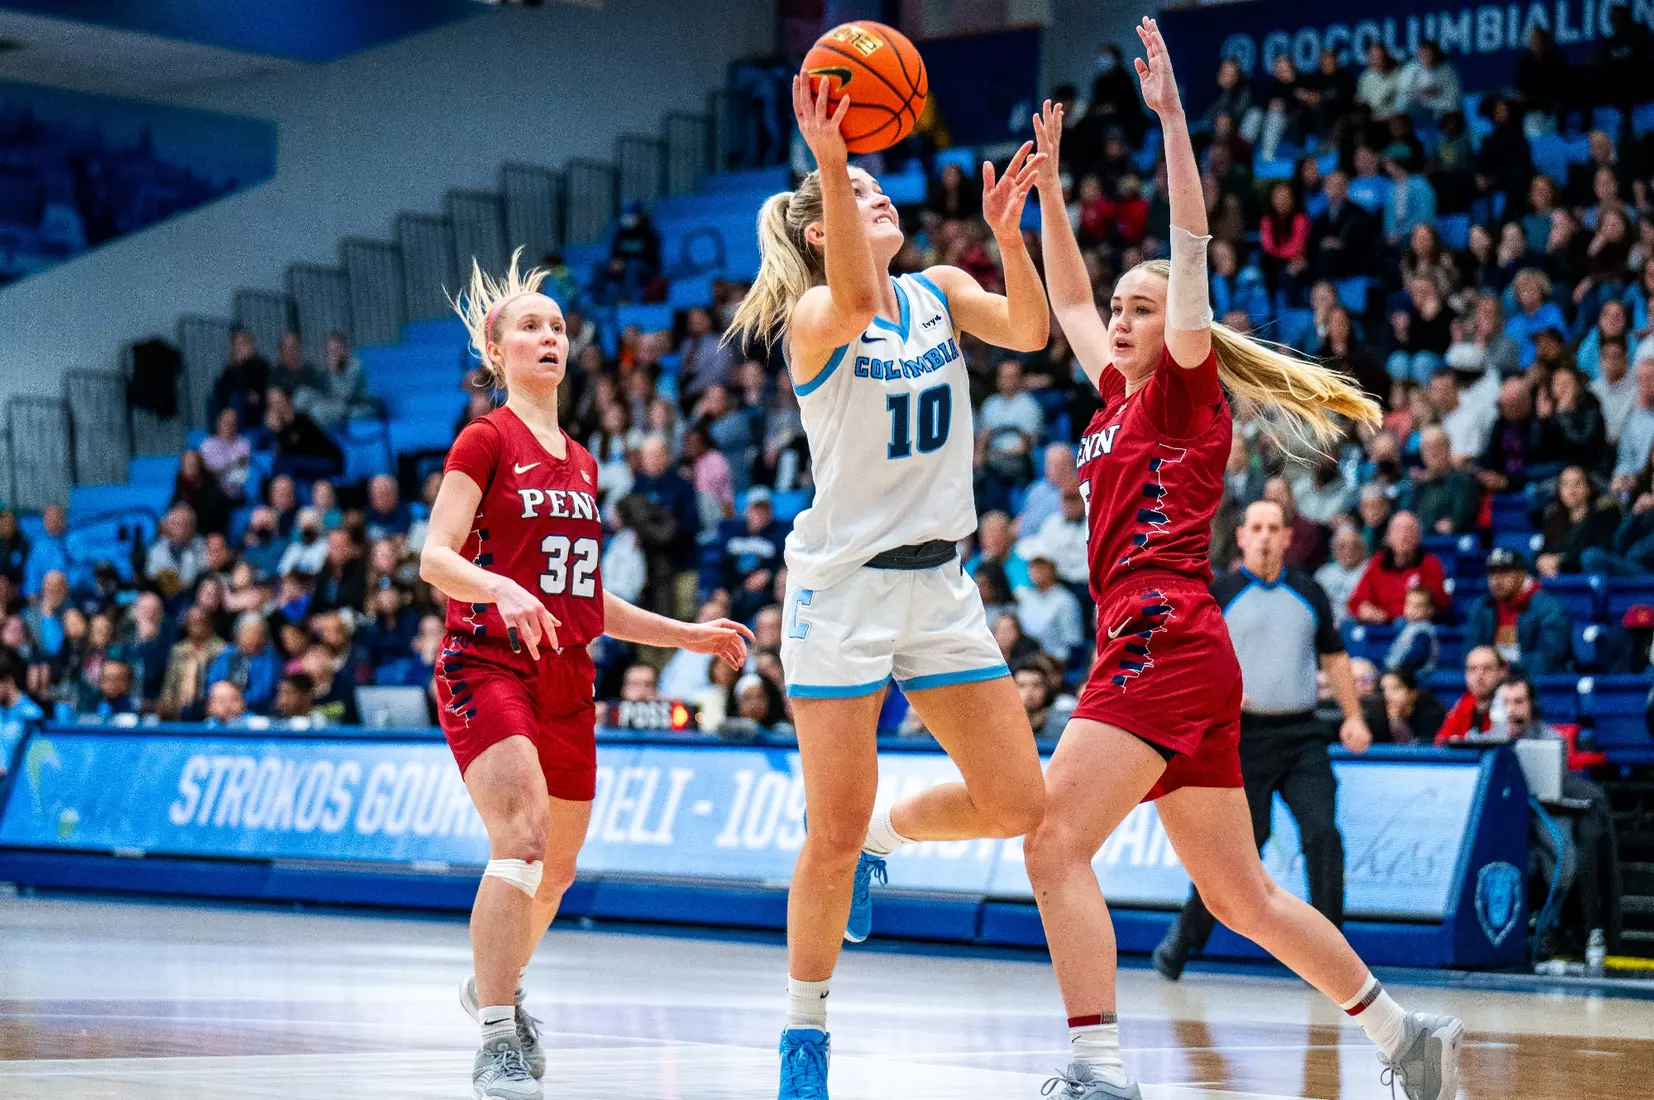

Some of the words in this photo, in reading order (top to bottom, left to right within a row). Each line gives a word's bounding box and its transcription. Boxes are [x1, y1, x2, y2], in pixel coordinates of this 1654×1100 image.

[886, 383, 953, 460] 10
[1076, 424, 1121, 469] ENN
[539, 533, 600, 599] 32
[168, 755, 362, 833] STROKOS
[355, 761, 489, 838] GOUR
